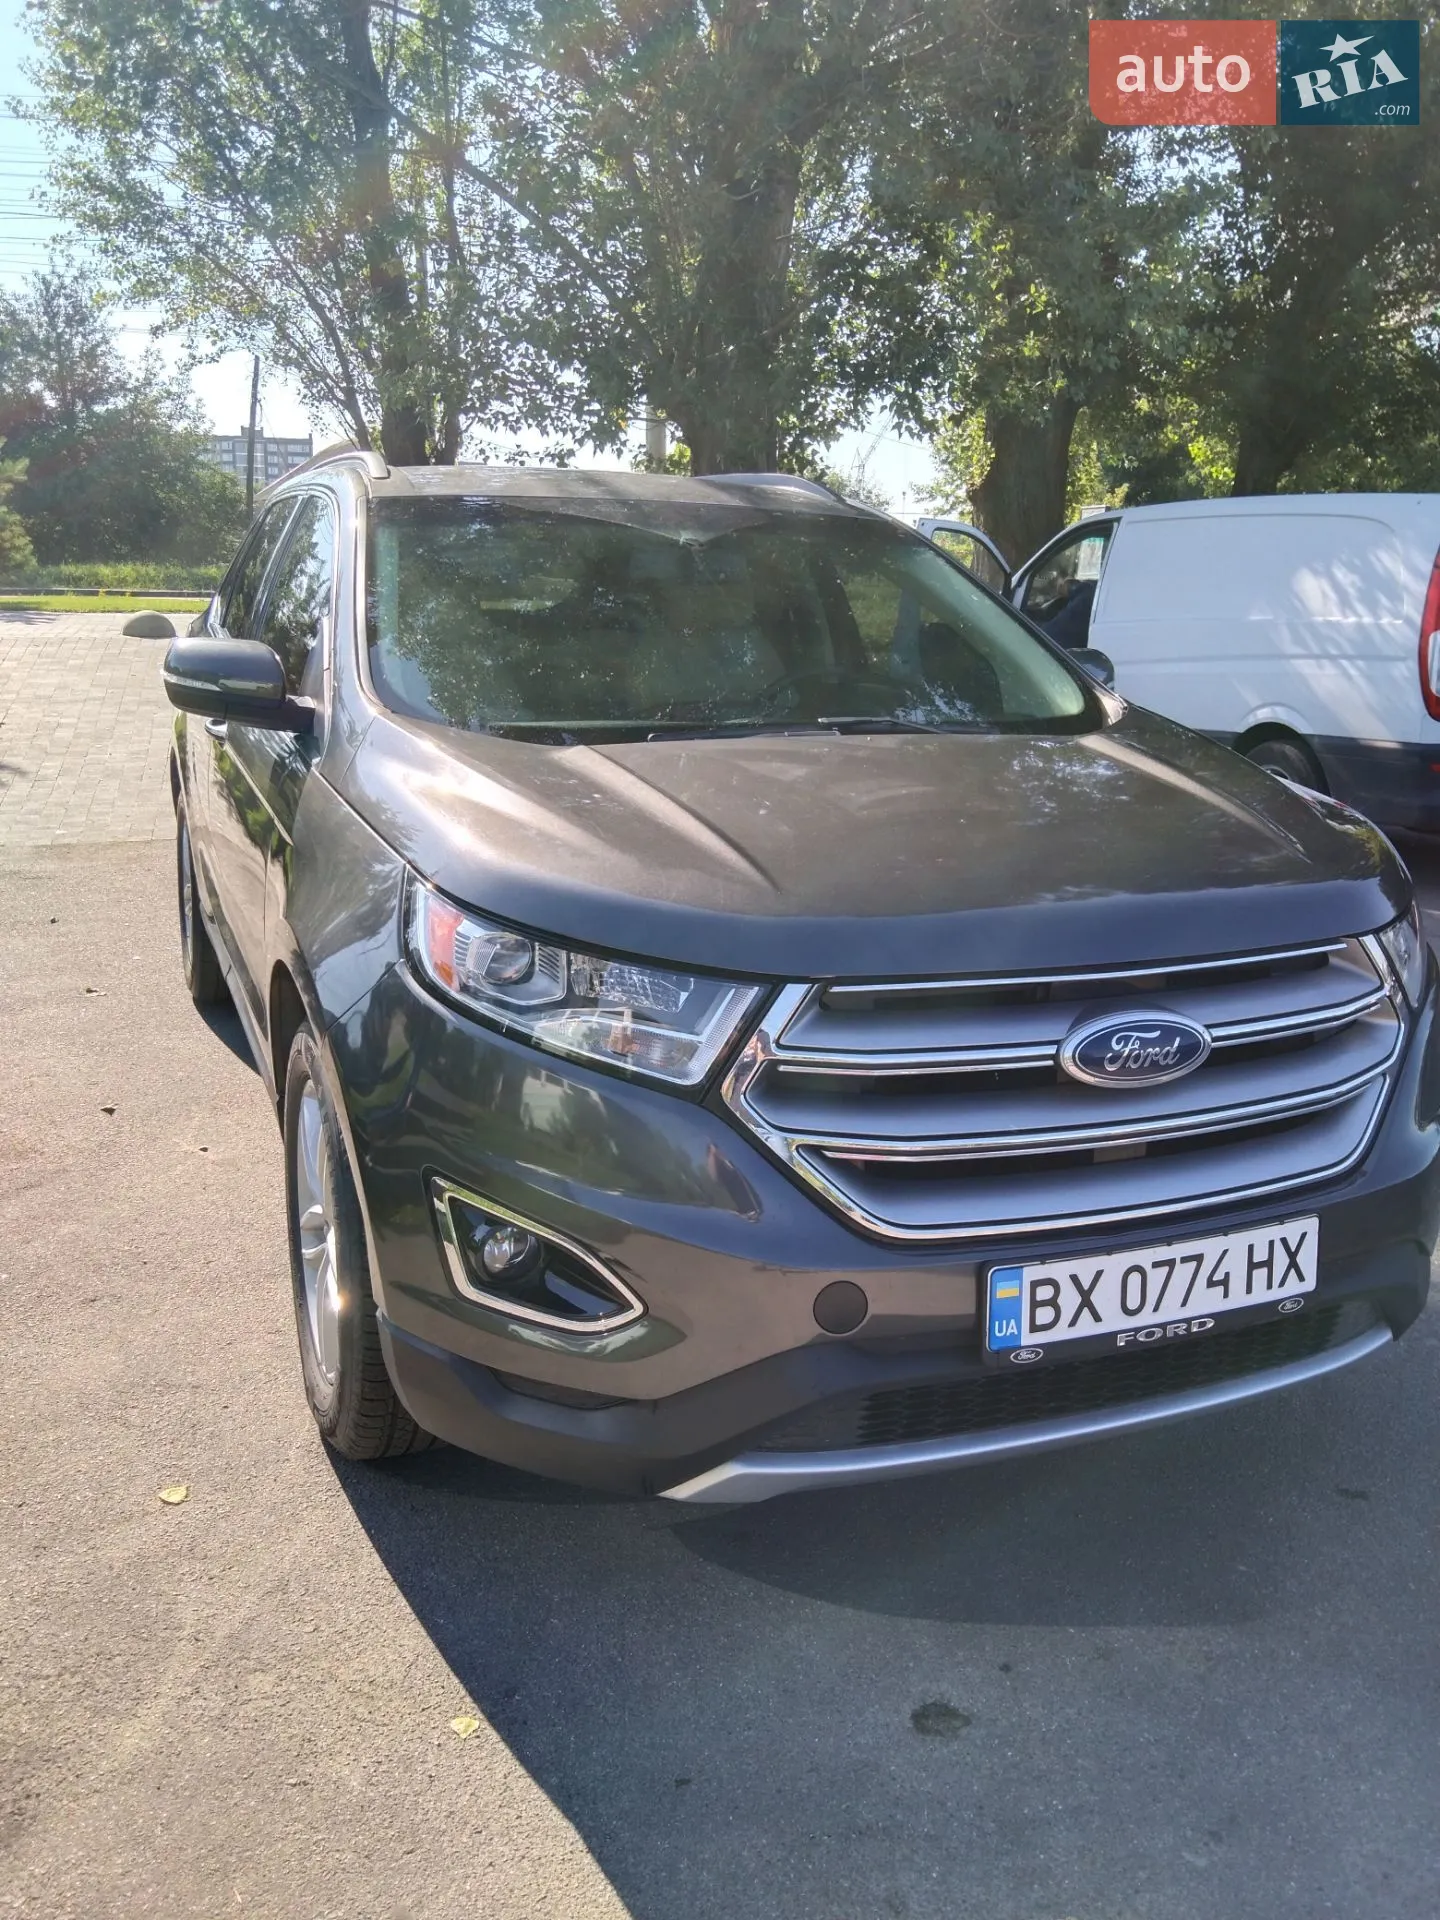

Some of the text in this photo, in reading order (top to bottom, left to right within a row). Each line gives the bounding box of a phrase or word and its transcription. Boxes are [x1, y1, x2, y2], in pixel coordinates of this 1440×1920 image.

[1104, 1030, 1181, 1072] Ford
[1029, 1231, 1308, 1334] BX 0774 HX
[995, 1320, 1018, 1337] UA
[1117, 1318, 1215, 1347] FORD
